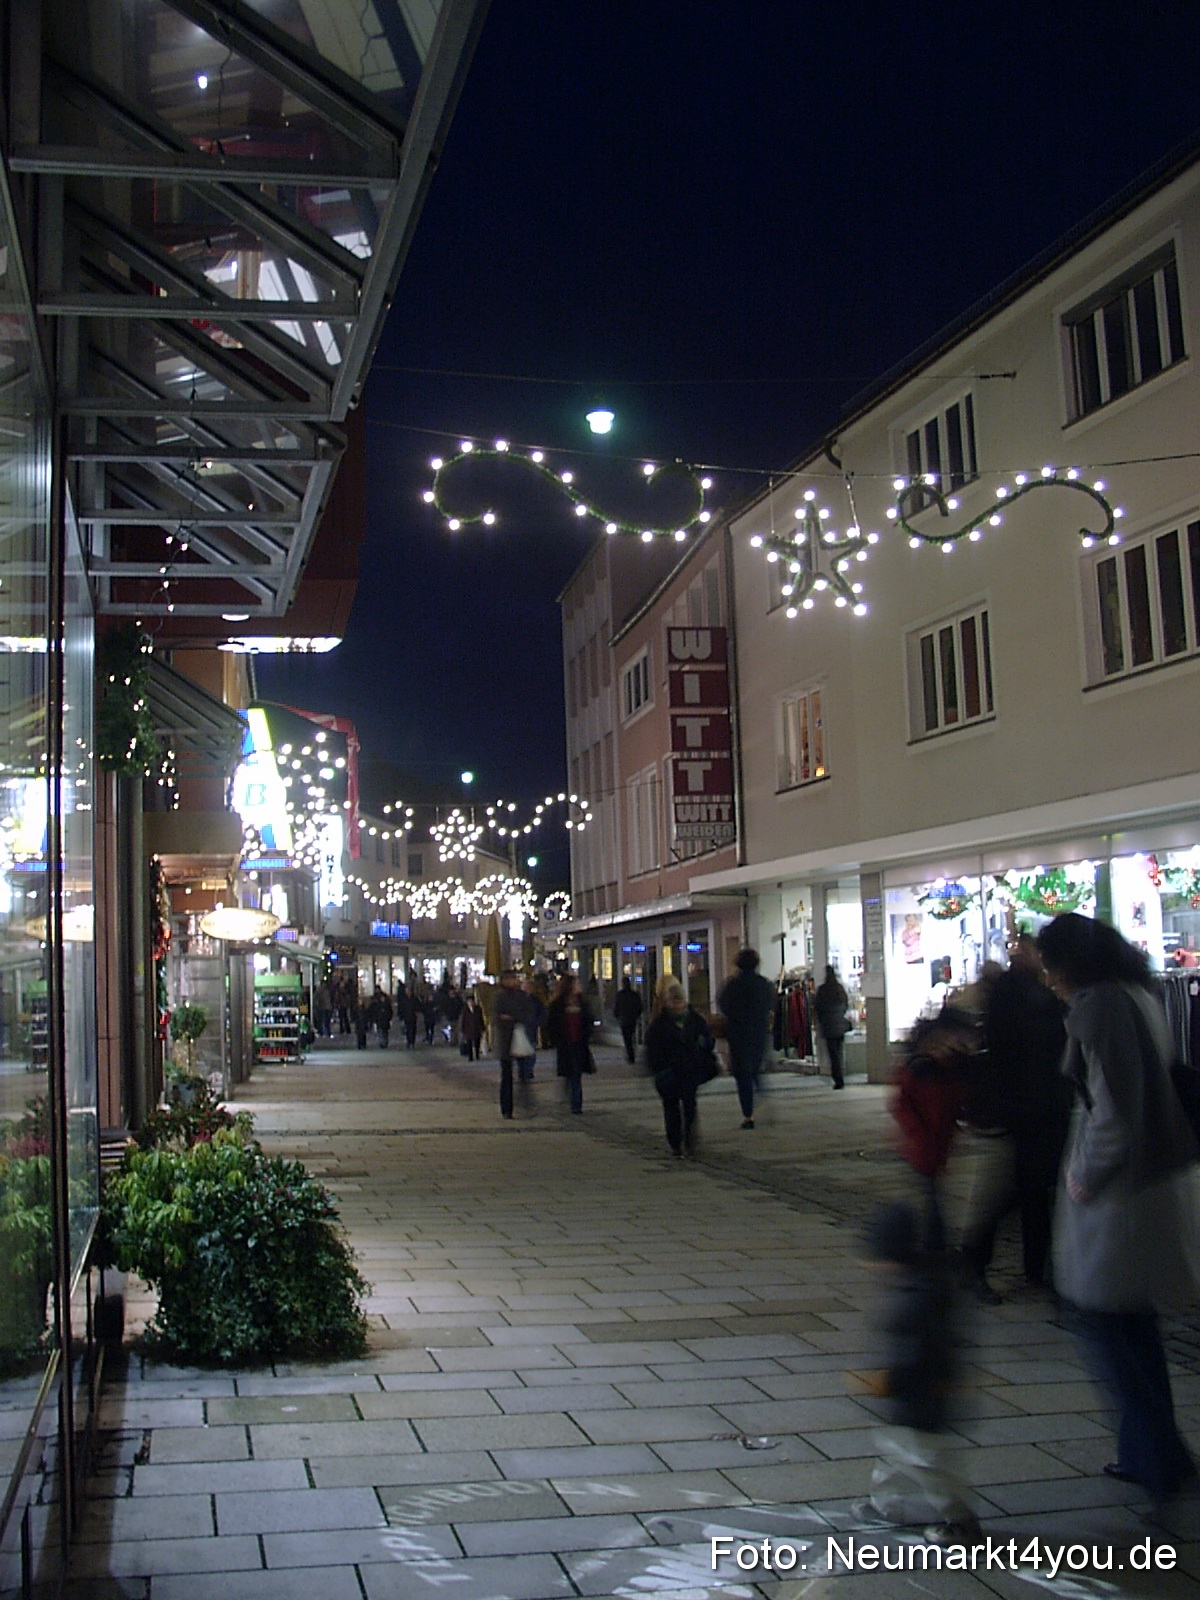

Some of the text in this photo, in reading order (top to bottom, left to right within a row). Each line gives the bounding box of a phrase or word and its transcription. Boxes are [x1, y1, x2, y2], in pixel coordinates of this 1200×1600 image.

[671, 630, 713, 792] WITT
[676, 804, 731, 822] WITT
[678, 823, 732, 837] WEIDEN
